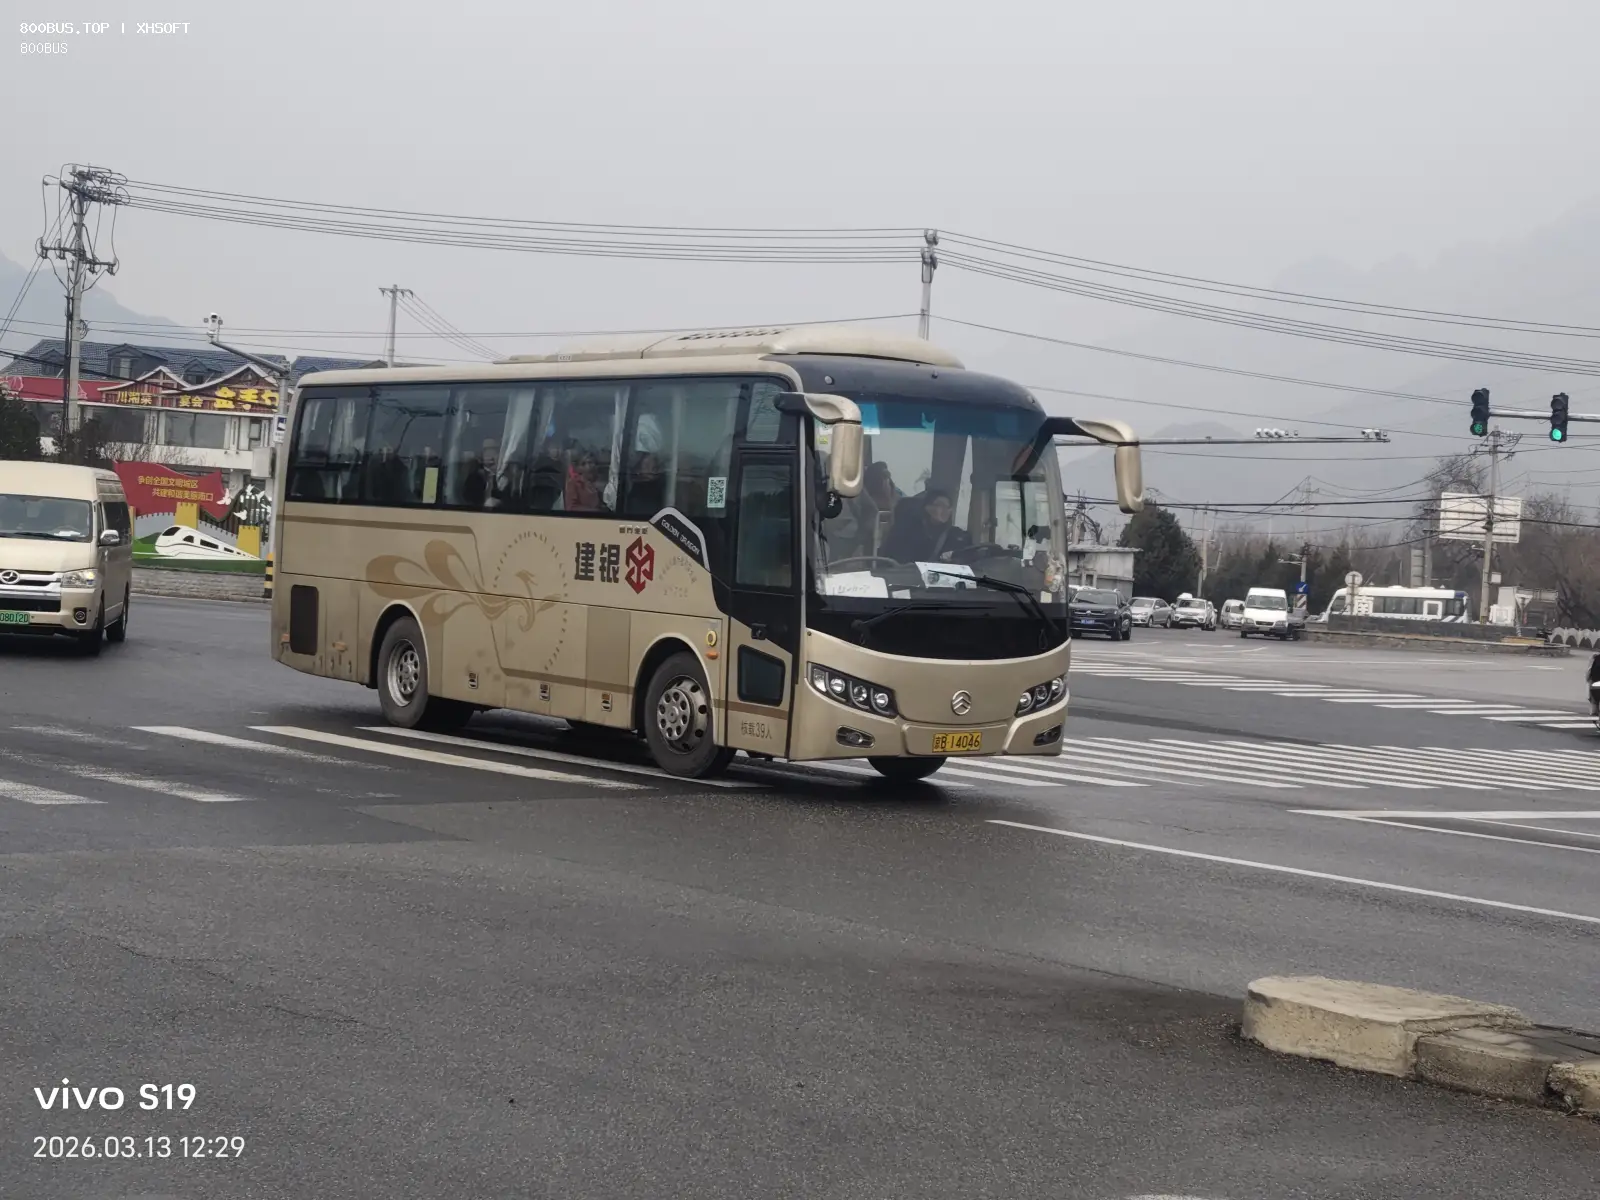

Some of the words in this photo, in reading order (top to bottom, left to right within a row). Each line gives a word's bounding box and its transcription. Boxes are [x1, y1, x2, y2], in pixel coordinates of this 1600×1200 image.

[661, 518, 680, 538] GOLDEN
[680, 534, 701, 556] DRAGON
[574, 541, 621, 583] 建银
